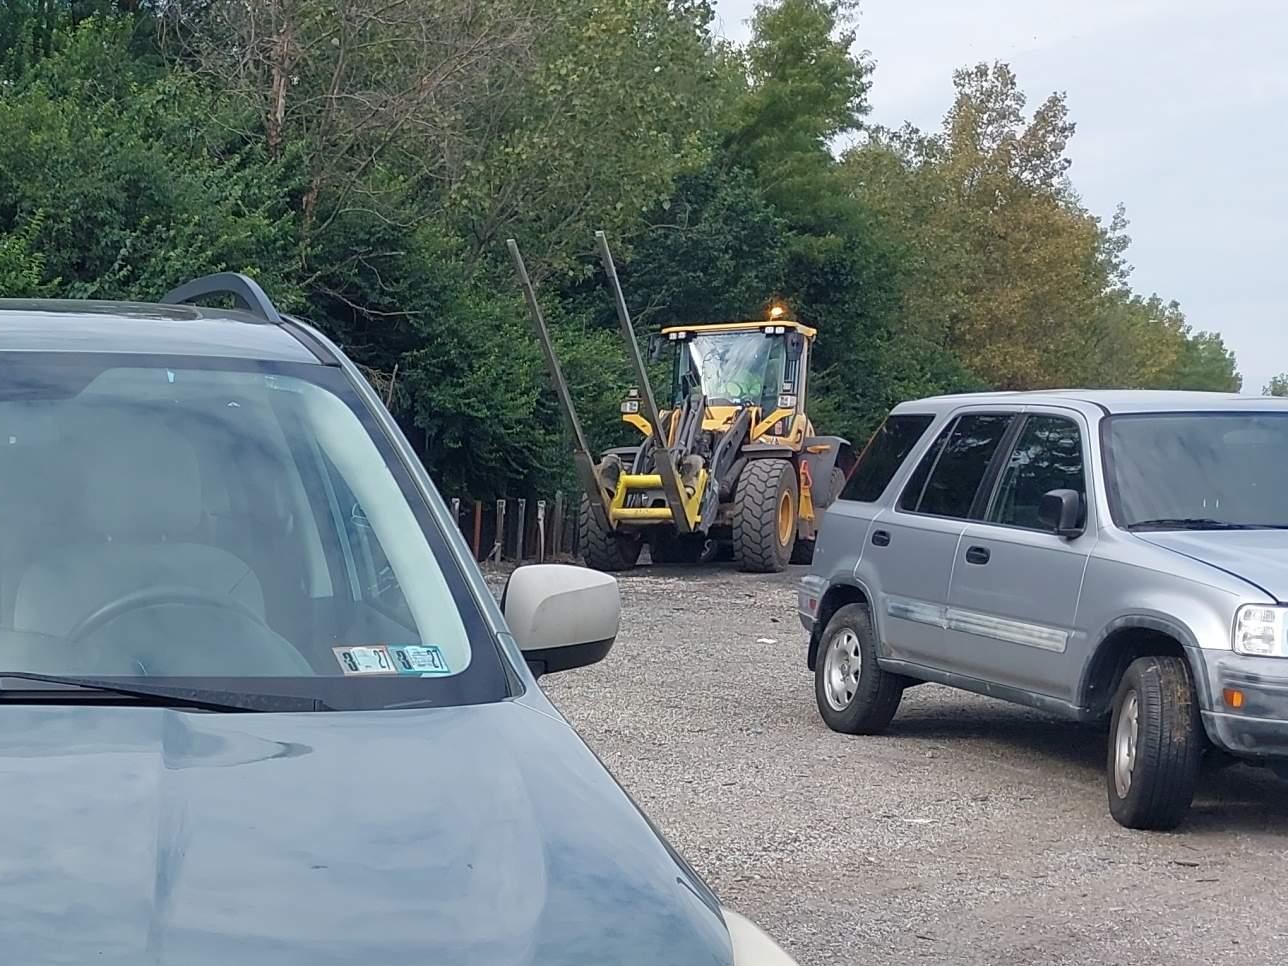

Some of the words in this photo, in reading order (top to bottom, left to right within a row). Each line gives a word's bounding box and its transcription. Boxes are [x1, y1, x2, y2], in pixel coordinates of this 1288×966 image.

[342, 651, 358, 672] 3
[373, 649, 391, 670] 27
[395, 650, 412, 670] 3
[426, 649, 444, 669] 27
